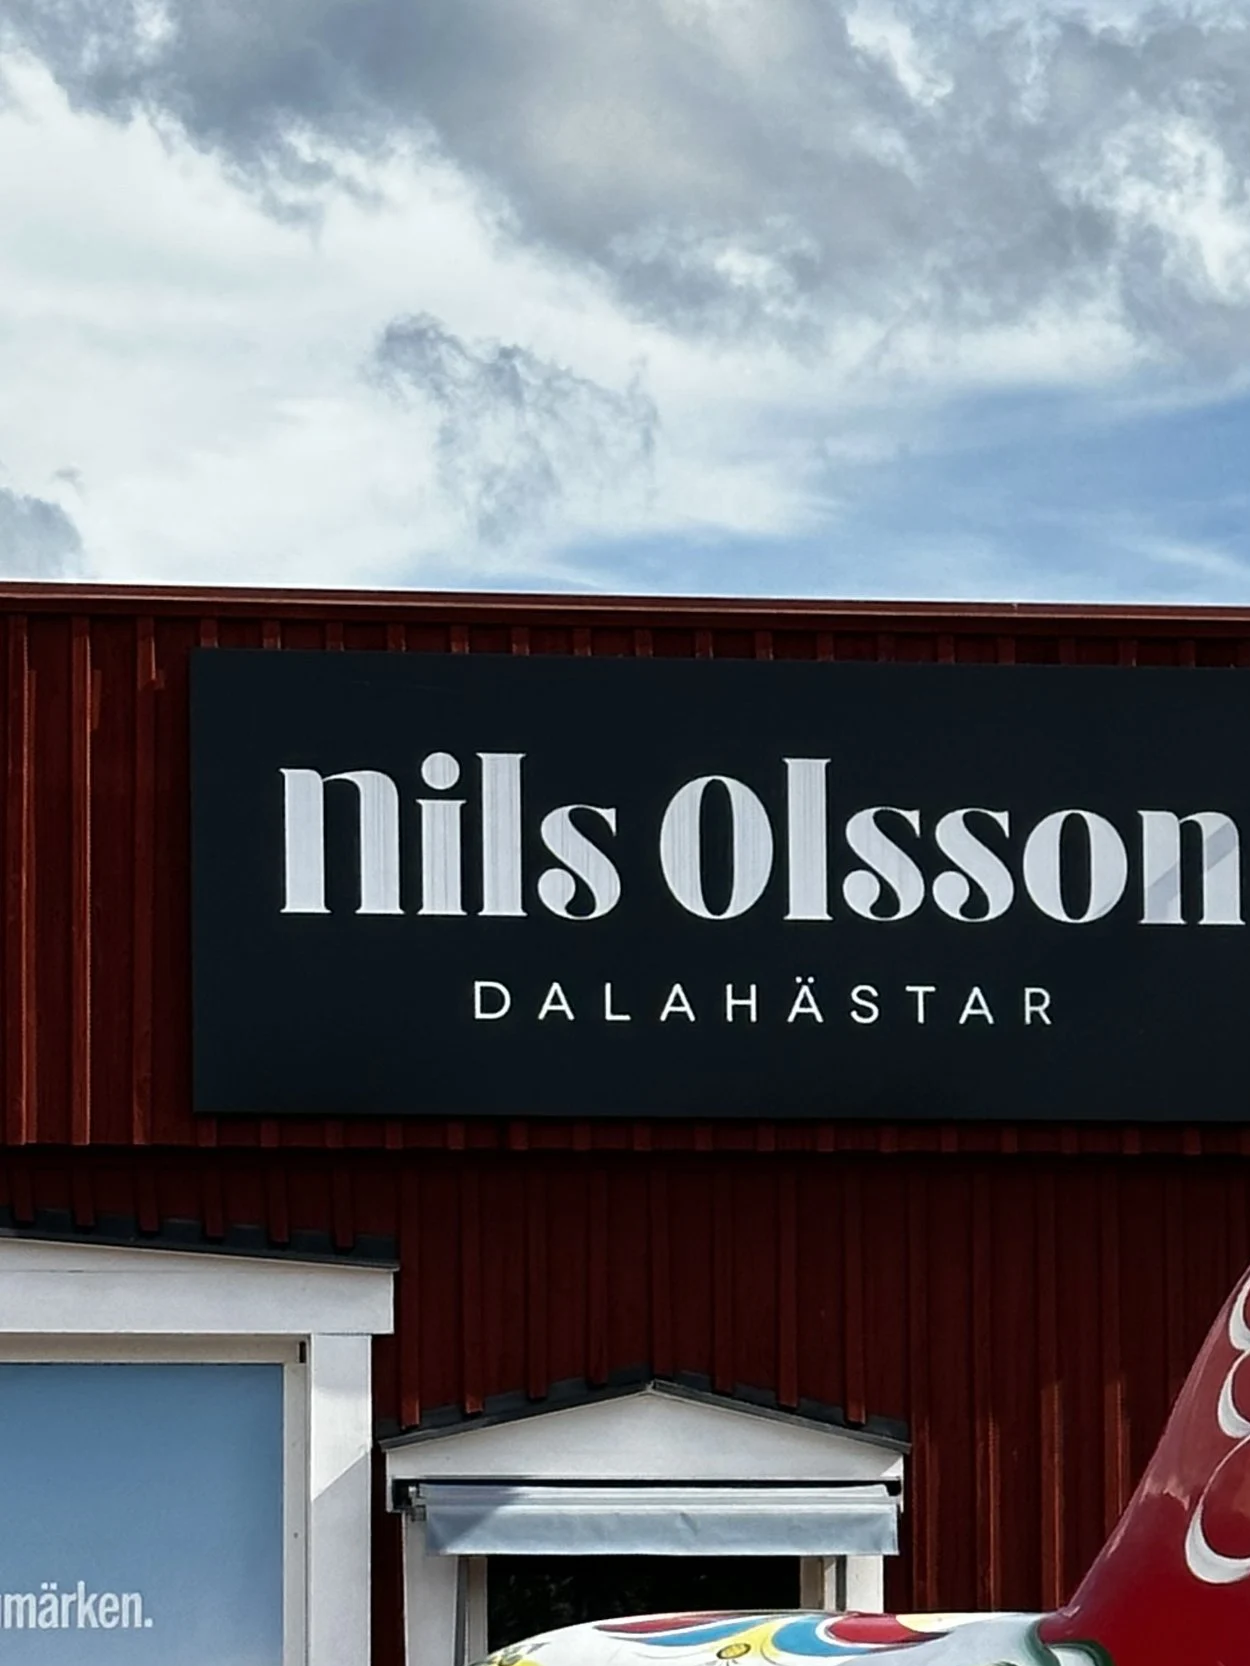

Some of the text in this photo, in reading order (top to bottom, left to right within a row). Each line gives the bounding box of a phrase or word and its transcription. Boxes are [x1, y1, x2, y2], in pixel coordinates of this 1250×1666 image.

[659, 757, 1246, 926] Olsson
[473, 976, 1053, 1026] DALAHÄSTAR
[0, 1580, 154, 1629] märken.
